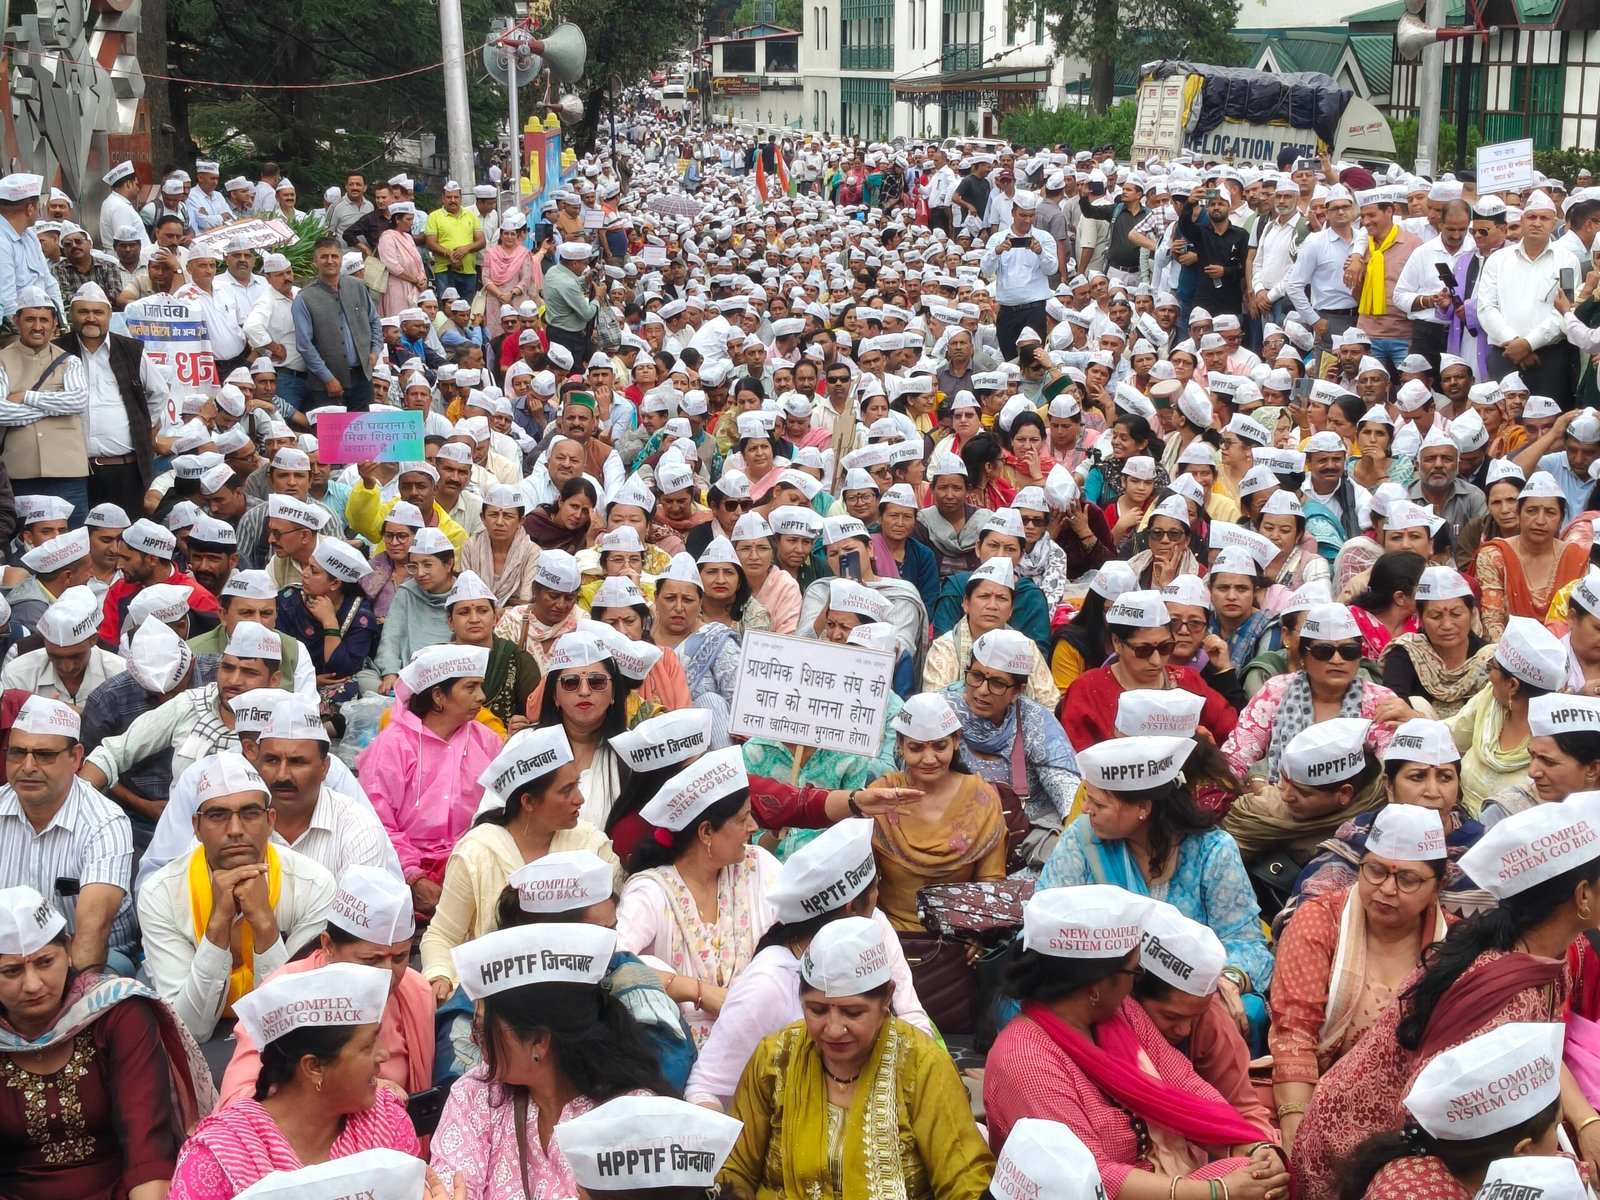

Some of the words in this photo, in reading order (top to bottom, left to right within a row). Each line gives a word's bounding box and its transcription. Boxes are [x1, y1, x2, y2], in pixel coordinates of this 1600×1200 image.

[1184, 133, 1274, 160] RELOCATION
[163, 301, 189, 319] चंबा
[409, 419, 417, 430] है
[1241, 423, 1260, 438] HPPTF
[372, 431, 399, 442] शिक्षा
[402, 432, 418, 441] को
[278, 506, 303, 521] HPPTF
[782, 521, 805, 531] HPPTF
[1227, 530, 1243, 541] NEW
[143, 535, 169, 552] HPPTF
[1222, 535, 1248, 548] SYSTEM
[327, 556, 349, 575] HPPTF
[843, 599, 872, 613] SYSTEM
[848, 593, 866, 605] NEW
[1119, 604, 1145, 619] जिन्दाबाद
[173, 649, 188, 683] HPPTF
[433, 657, 473, 674] COMPLEX
[1509, 645, 1542, 675] COMPLEX
[415, 673, 442, 688] SYSTEM
[442, 664, 456, 676] GO
[747, 657, 794, 683] प्राथमिक
[800, 662, 837, 690] शिक्षक
[843, 673, 864, 695] संघ
[870, 675, 887, 699] की
[1521, 665, 1546, 683] BACK
[756, 689, 779, 709] बात
[785, 688, 802, 712] को
[808, 697, 844, 720] मानना
[849, 698, 876, 726] होगा
[1551, 708, 1594, 724] HPPTF
[49, 716, 74, 728] SYSTEM
[1139, 722, 1177, 731] SYSTEM
[1148, 713, 1169, 723] NEW
[743, 713, 765, 729] वरना
[769, 716, 810, 737] खामियाजा
[815, 725, 845, 744] भुगतना
[629, 743, 666, 764] HPPTF
[667, 731, 704, 756] जिन्दाबाद
[491, 765, 516, 793] HPPTF
[516, 747, 558, 776] जिन्दाबाद
[1101, 763, 1145, 781] HPPTF
[1308, 757, 1347, 777] HPPTF
[666, 788, 687, 810] NEW
[685, 761, 731, 795] COMPLEX
[668, 792, 699, 823] SYSTEM
[699, 780, 715, 796] GO
[714, 768, 740, 786] BACK
[1501, 847, 1528, 867] NEW
[1530, 819, 1590, 853] COMPLEX
[1497, 853, 1549, 882] SYSTEM
[1548, 842, 1572, 860] GO
[1573, 829, 1599, 851] BACK
[529, 877, 581, 892] COMPLEX
[537, 890, 553, 901] GO
[556, 886, 590, 901] BACK
[800, 879, 847, 914] HPPTF
[331, 901, 345, 914] GO
[343, 910, 372, 929] BACK
[1049, 938, 1101, 951] SYSTEM
[1104, 938, 1122, 950] GO
[1123, 936, 1139, 949] BAC
[1059, 928, 1090, 939] NEW
[859, 947, 877, 964] NEW
[1144, 935, 1195, 981] जिन्दाबाद
[480, 954, 537, 985] HPPTF
[541, 949, 594, 973] जिन्दाबाद
[855, 955, 885, 978] SYSTEM
[261, 1006, 284, 1027] NEW
[286, 997, 353, 1015] COMPLEX
[262, 1016, 295, 1041] SYSTEM
[295, 1010, 320, 1023] GO
[324, 1009, 363, 1022] BACK
[1450, 1088, 1485, 1109] NEW
[1488, 1055, 1550, 1095] COMPLEX
[1446, 1095, 1506, 1123] SYSTEM
[1508, 1083, 1529, 1102] GO
[597, 1148, 666, 1176] HPPTF
[1000, 1176, 1016, 1196] GO
[1001, 1156, 1043, 1198] COMPLEX
